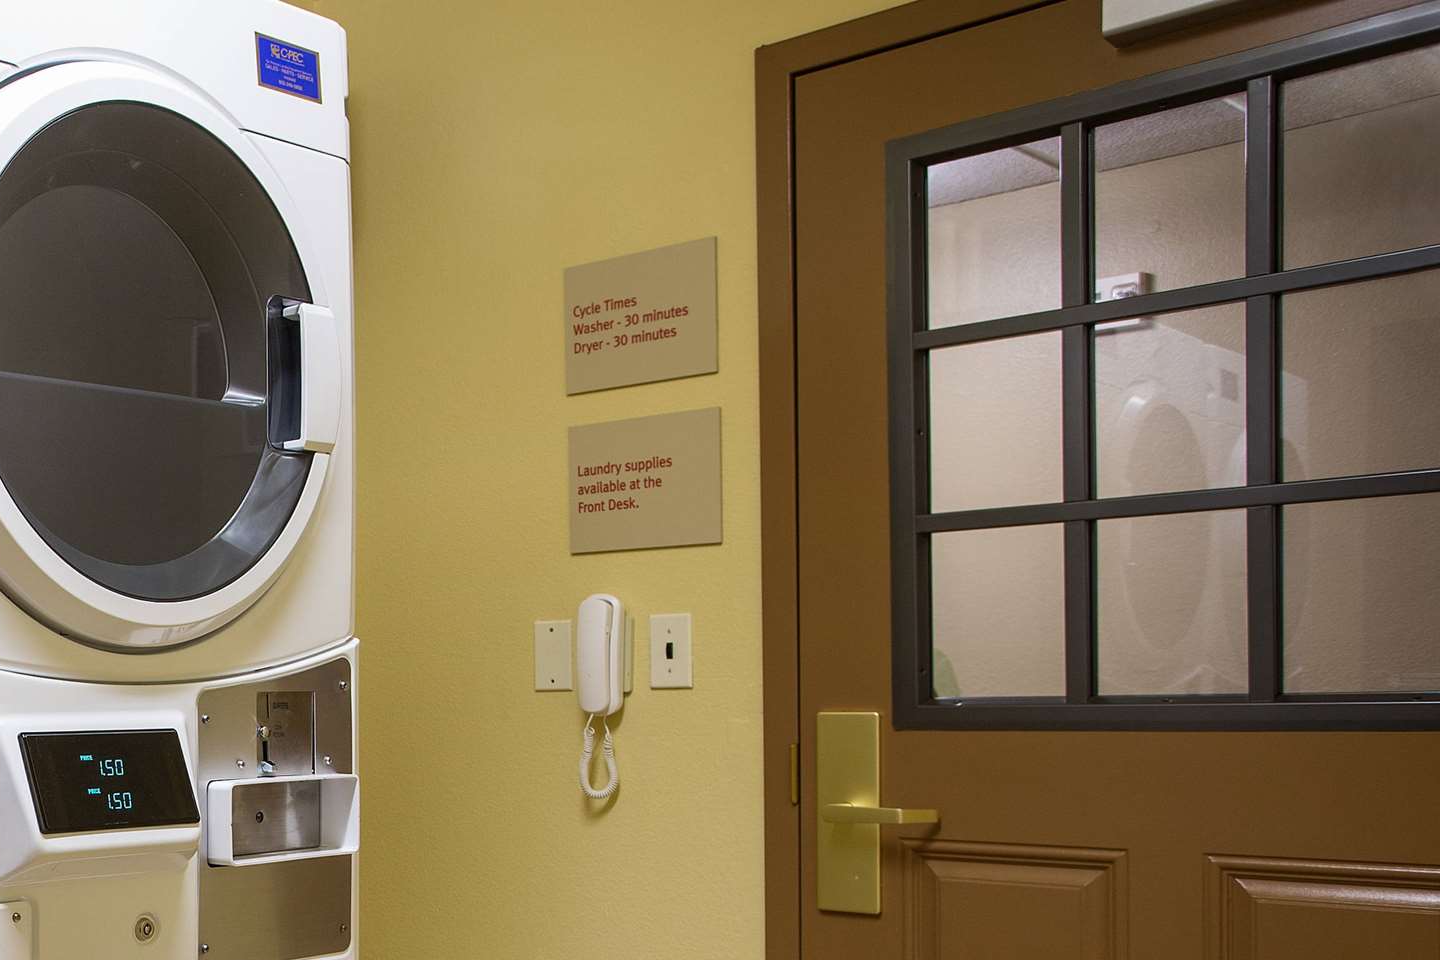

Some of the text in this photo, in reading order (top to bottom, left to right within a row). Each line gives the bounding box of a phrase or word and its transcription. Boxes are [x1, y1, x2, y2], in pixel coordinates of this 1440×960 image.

[573, 297, 637, 320] Cycle Times
[573, 318, 614, 336] Washer
[624, 313, 639, 327] 30
[642, 305, 689, 323] minutes
[574, 339, 603, 355] Dryer
[613, 334, 628, 348] 30
[631, 327, 677, 344] minutes
[577, 456, 673, 477] Laundry supplies
[577, 476, 662, 495] available at the
[578, 497, 639, 514] Front Desk.
[99, 759, 124, 776] 1.50
[107, 792, 132, 810] 1.50
